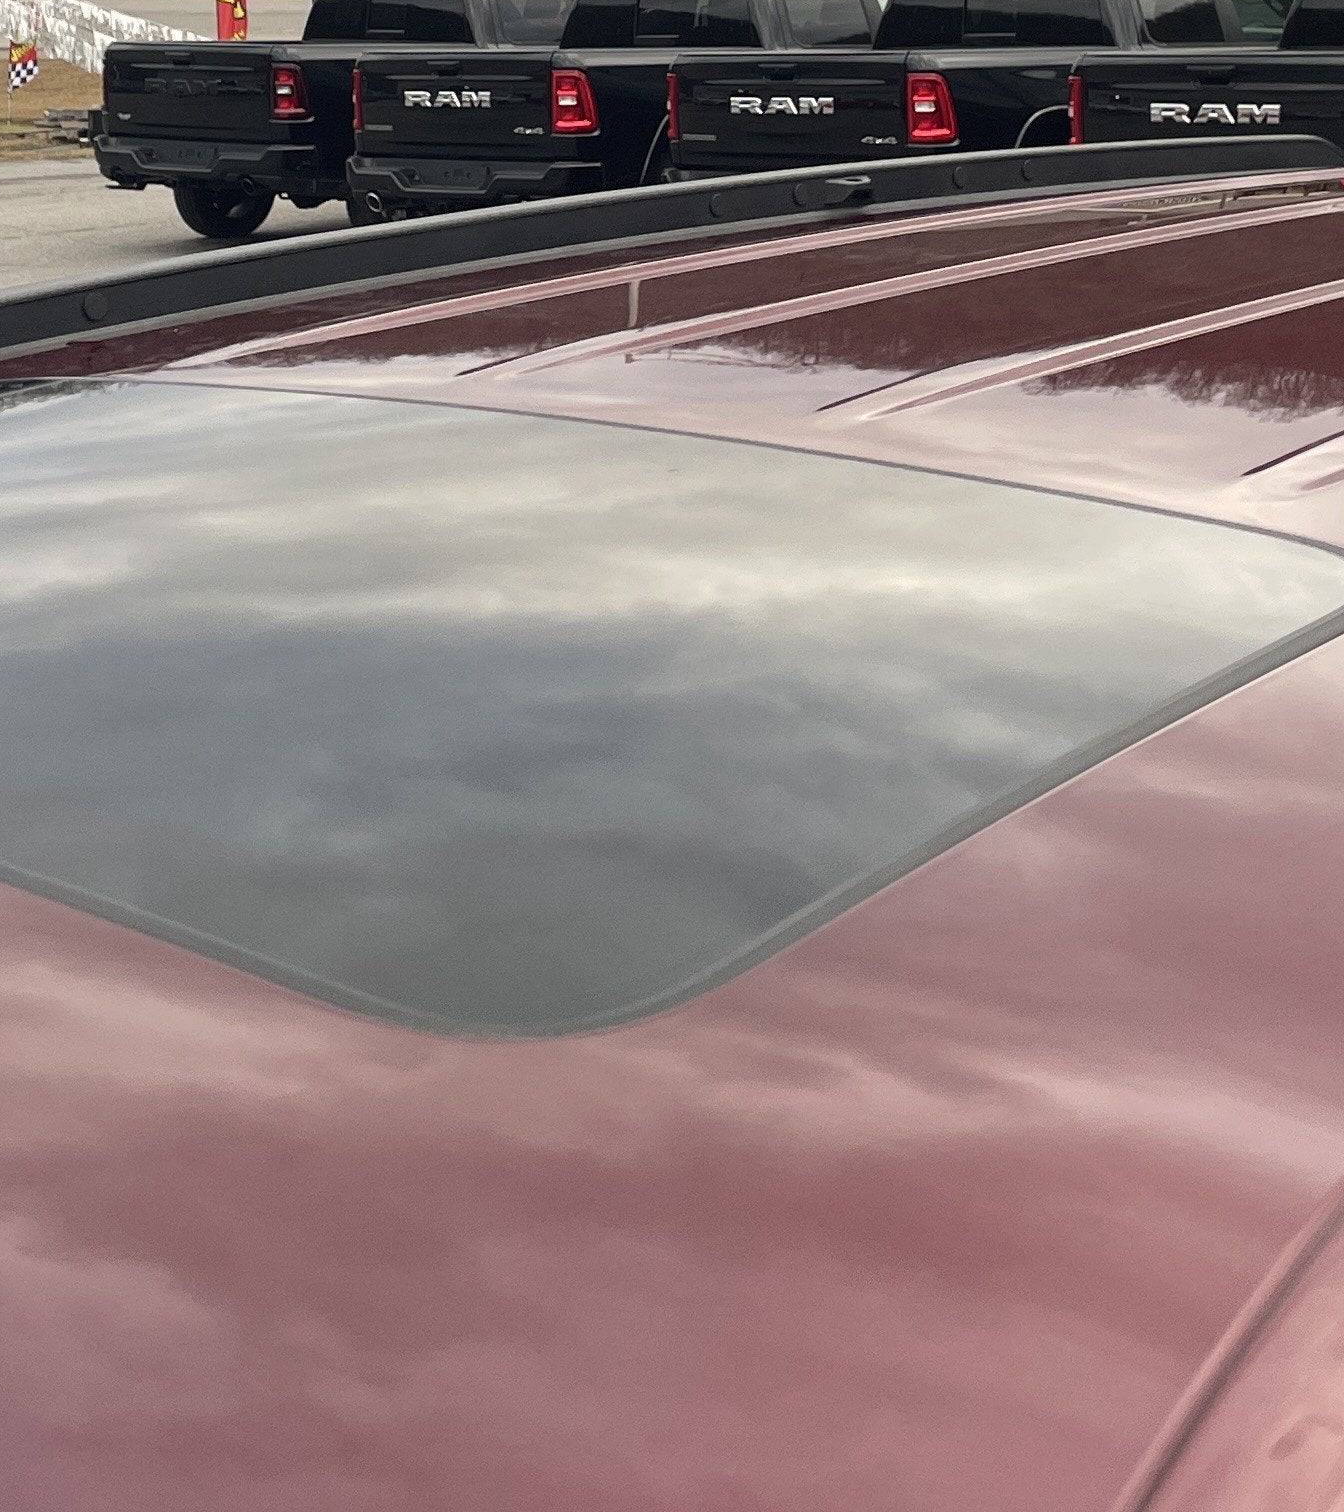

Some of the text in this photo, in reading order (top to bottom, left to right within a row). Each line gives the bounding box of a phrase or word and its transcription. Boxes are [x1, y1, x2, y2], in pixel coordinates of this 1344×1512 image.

[403, 90, 492, 108] RAM
[729, 96, 835, 115] RAM
[1149, 102, 1282, 125] RAM
